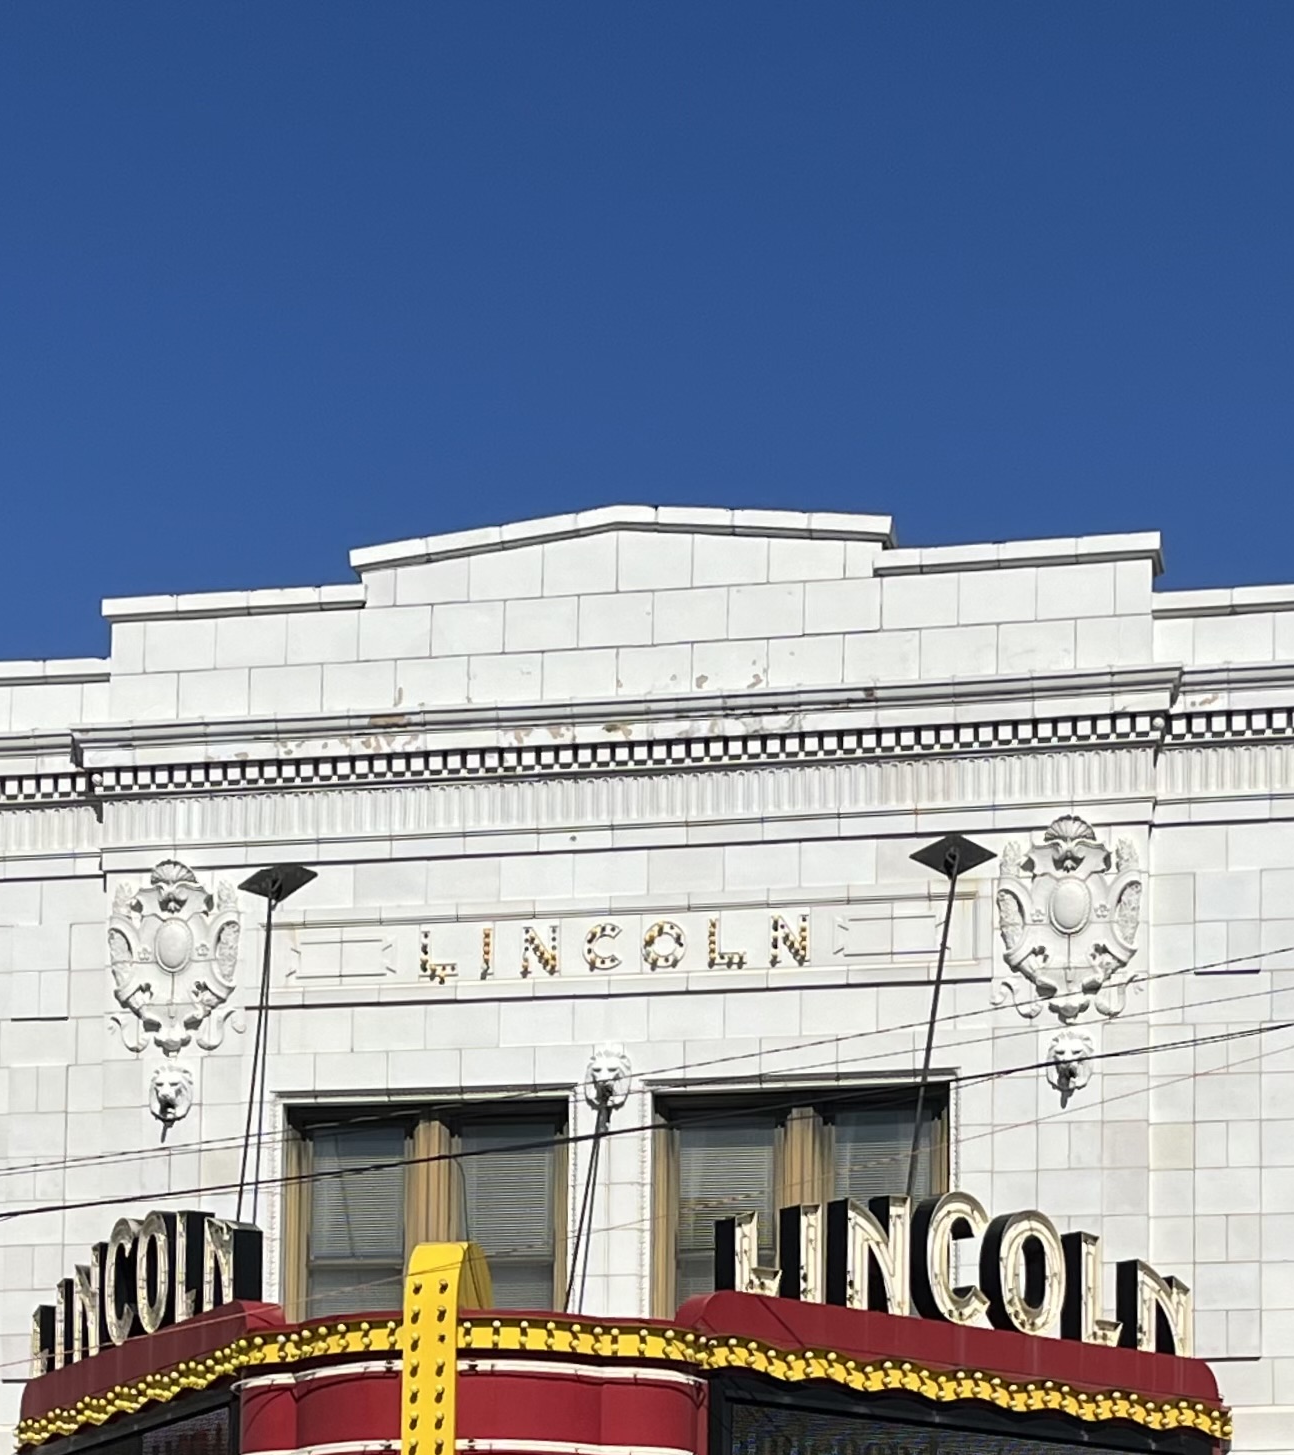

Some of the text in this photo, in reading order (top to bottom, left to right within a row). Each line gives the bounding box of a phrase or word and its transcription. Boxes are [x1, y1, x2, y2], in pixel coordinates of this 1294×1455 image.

[418, 914, 812, 984] LINCOLN
[31, 1210, 263, 1380] LINCOLN
[713, 1191, 1194, 1358] LINCOLN
